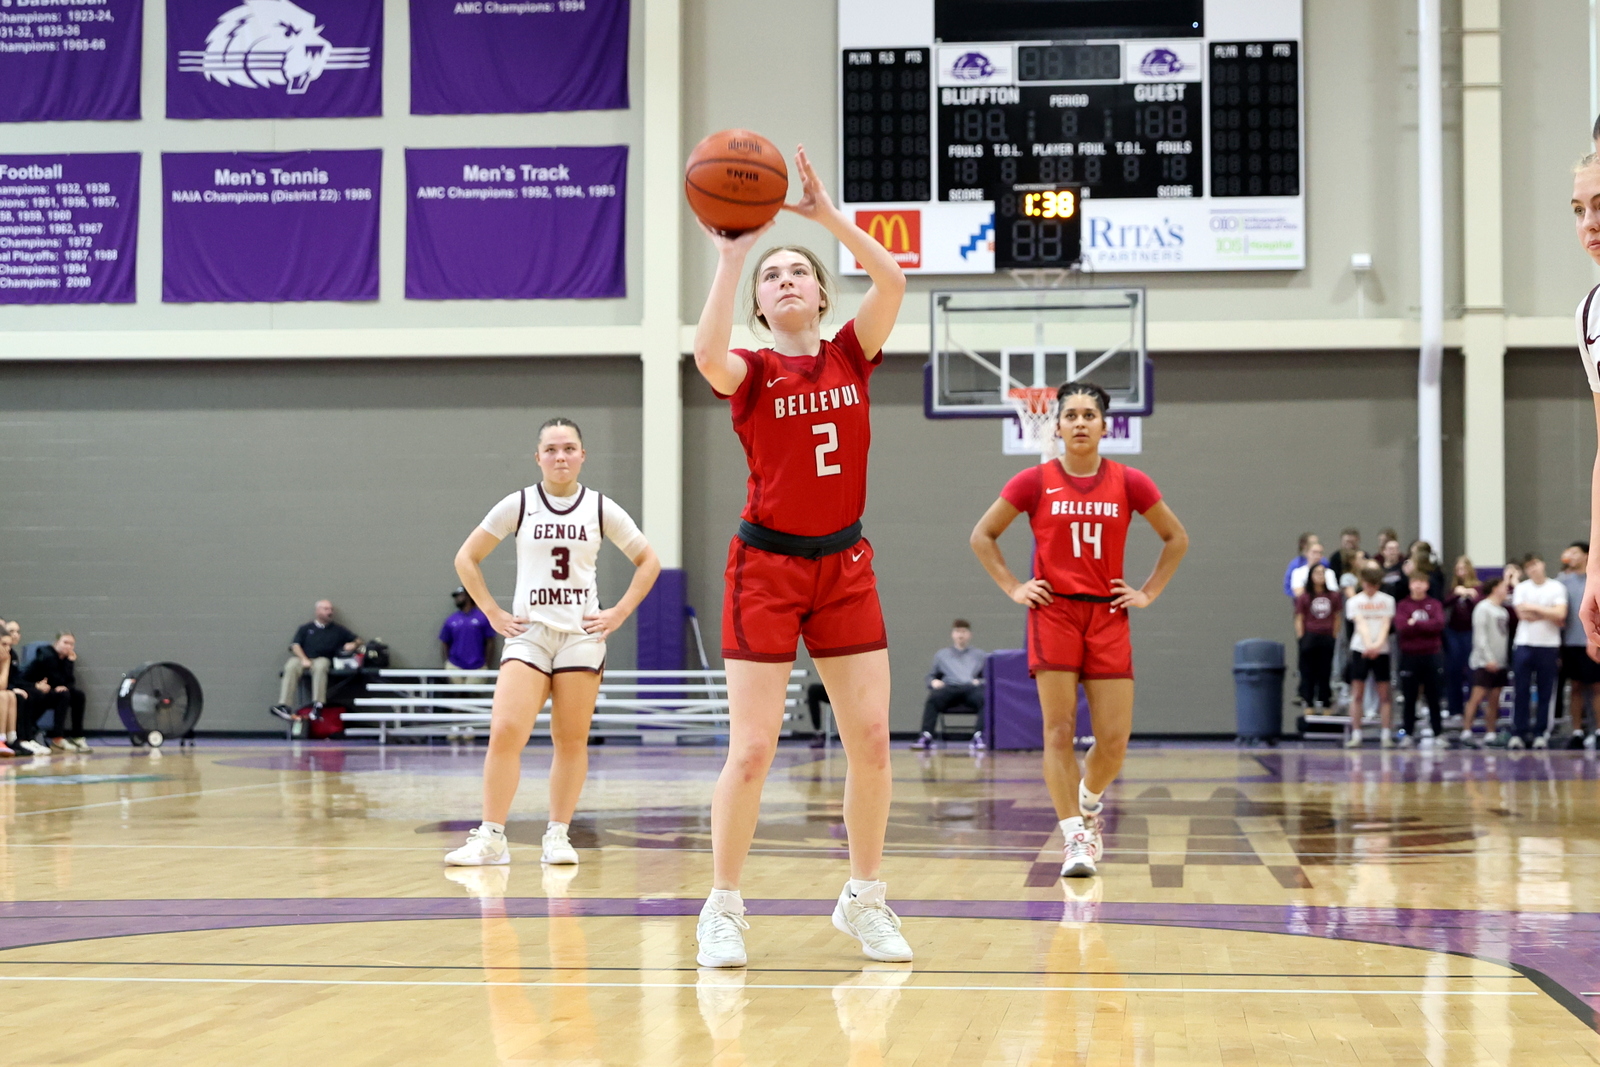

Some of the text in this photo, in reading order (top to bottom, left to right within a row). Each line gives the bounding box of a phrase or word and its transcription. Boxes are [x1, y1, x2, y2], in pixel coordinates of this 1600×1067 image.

[941, 87, 1020, 105] BLUFFTON
[1049, 93, 1089, 107] PERIOD
[1134, 84, 1186, 102] GUEST
[948, 144, 984, 158] FOULS
[1156, 140, 1192, 154] FOULS
[0, 163, 62, 180] Football
[214, 167, 329, 186] Men's Tennis
[463, 163, 570, 182] Men's Track
[203, 190, 269, 205] Champions
[948, 188, 984, 201] SCORE
[1157, 185, 1193, 199] SCORE
[1025, 190, 1075, 219] 1:38
[811, 422, 842, 477] 2
[1051, 501, 1119, 518] BELLEVUE
[533, 524, 588, 541] GENOA
[1070, 522, 1103, 560] 14
[551, 546, 570, 580] 3
